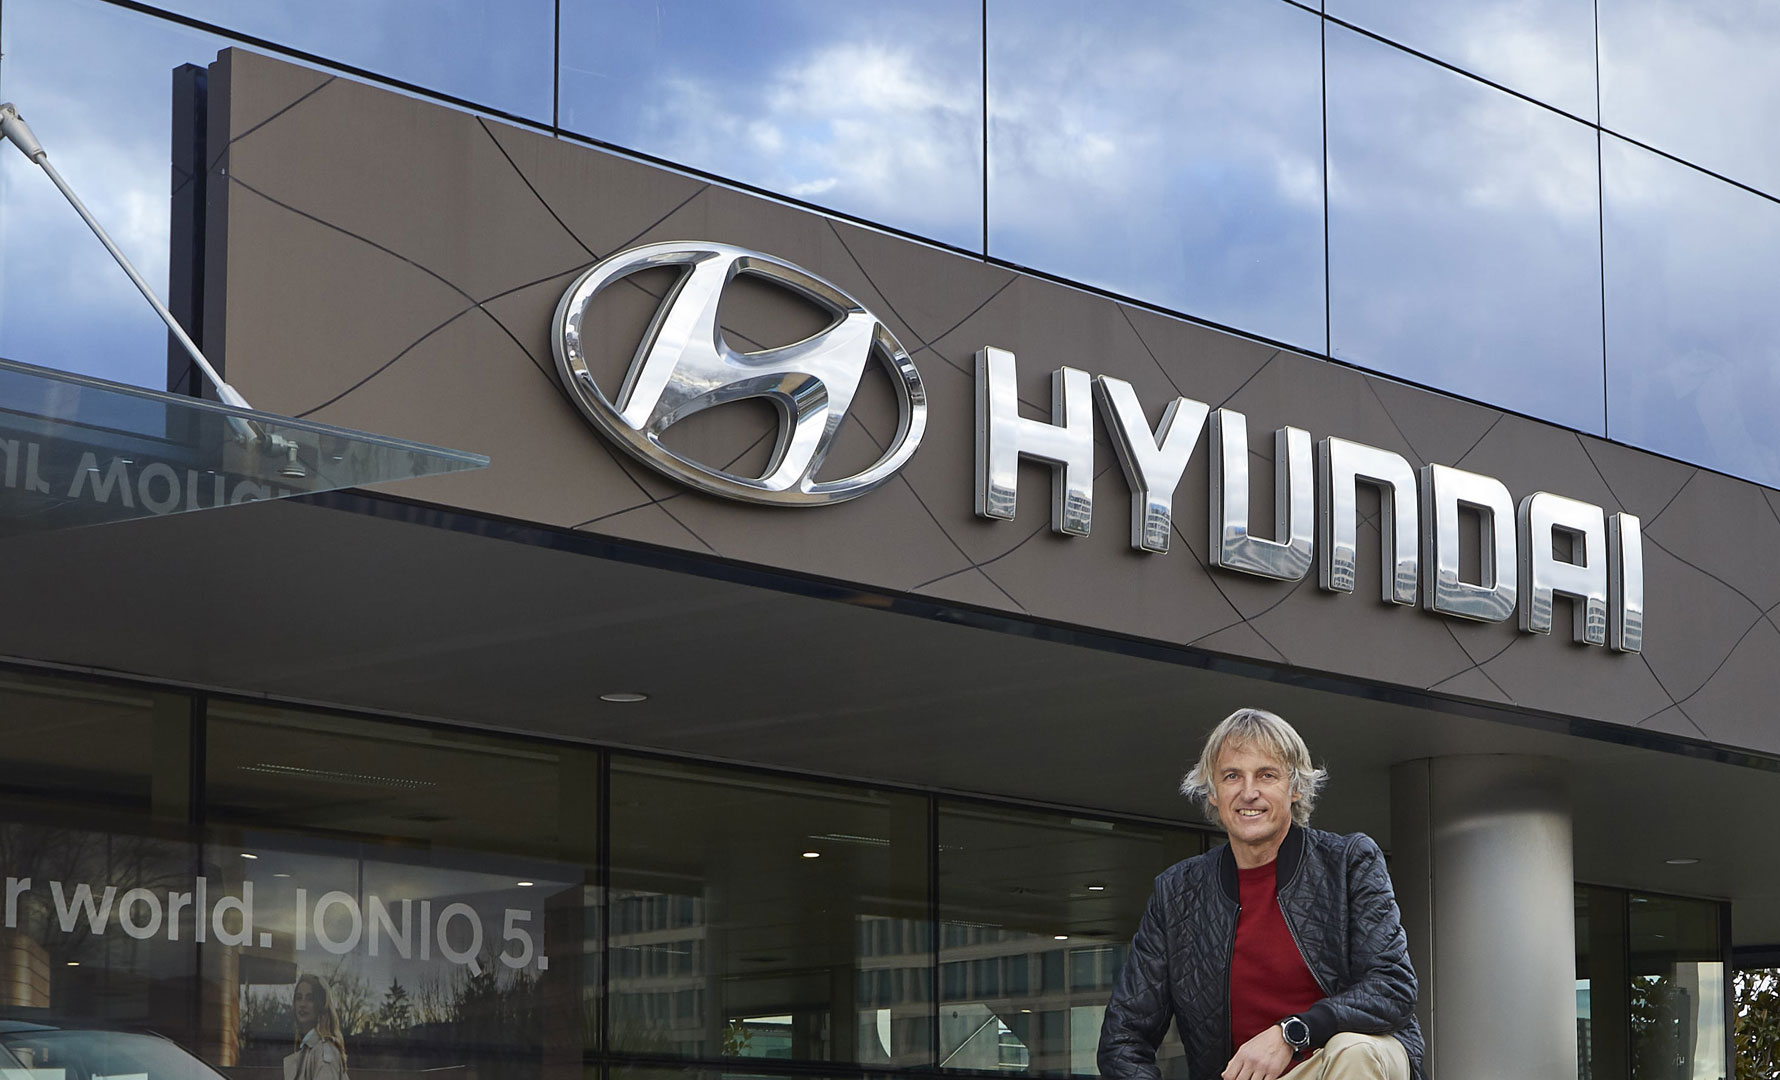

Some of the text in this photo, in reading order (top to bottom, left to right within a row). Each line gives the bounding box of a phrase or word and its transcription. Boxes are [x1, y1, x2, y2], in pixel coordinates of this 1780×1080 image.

[975, 345, 1643, 654] HYUNDAI
[49, 876, 274, 949] world.
[295, 887, 483, 977] IONIQ
[499, 908, 550, 971] 5.
